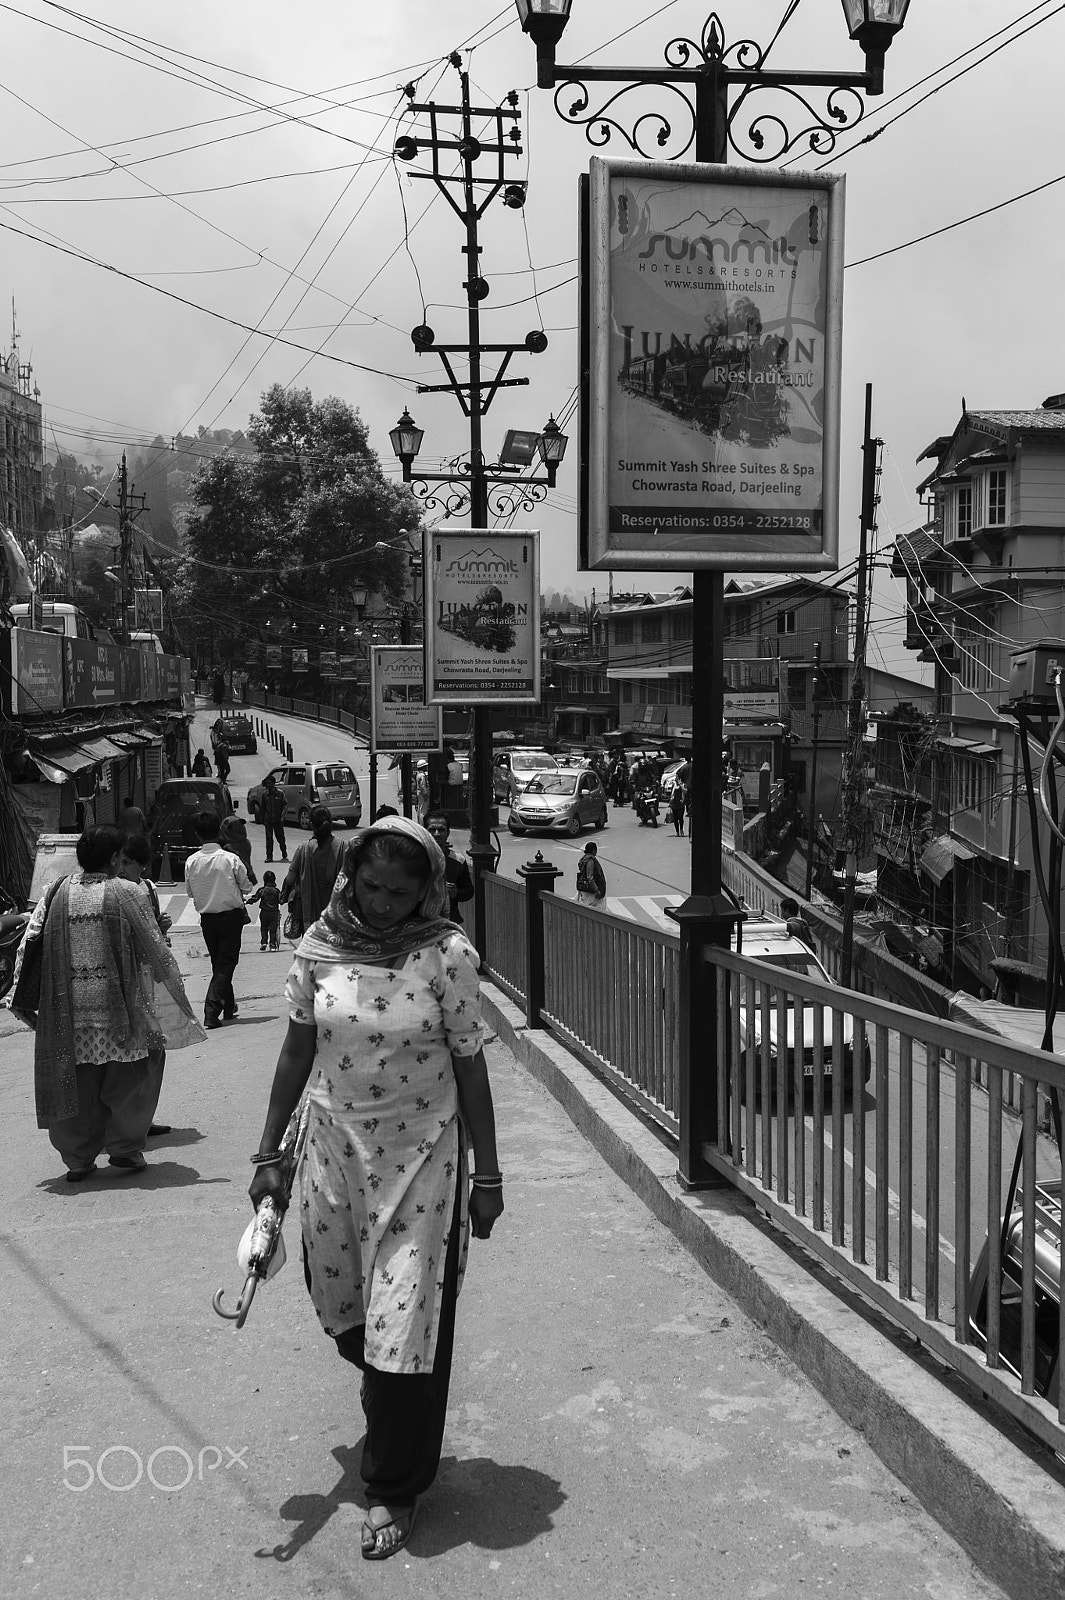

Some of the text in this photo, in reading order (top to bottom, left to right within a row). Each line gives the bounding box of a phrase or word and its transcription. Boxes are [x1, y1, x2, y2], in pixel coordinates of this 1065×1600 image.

[638, 234, 798, 266] summit
[664, 278, 775, 292] www.summithotels.in
[620, 325, 817, 366] JUNCTN
[714, 366, 814, 386] Restaurant
[618, 460, 814, 478] Summit Yash Shree Suites & Spa
[632, 479, 802, 496] Chowrasta Road, Darjeeling
[621, 514, 710, 527] Reservations:
[713, 516, 744, 527] 0354
[756, 516, 811, 528] 2252128
[446, 560, 518, 572] summit
[481, 616, 527, 625] Restaurant
